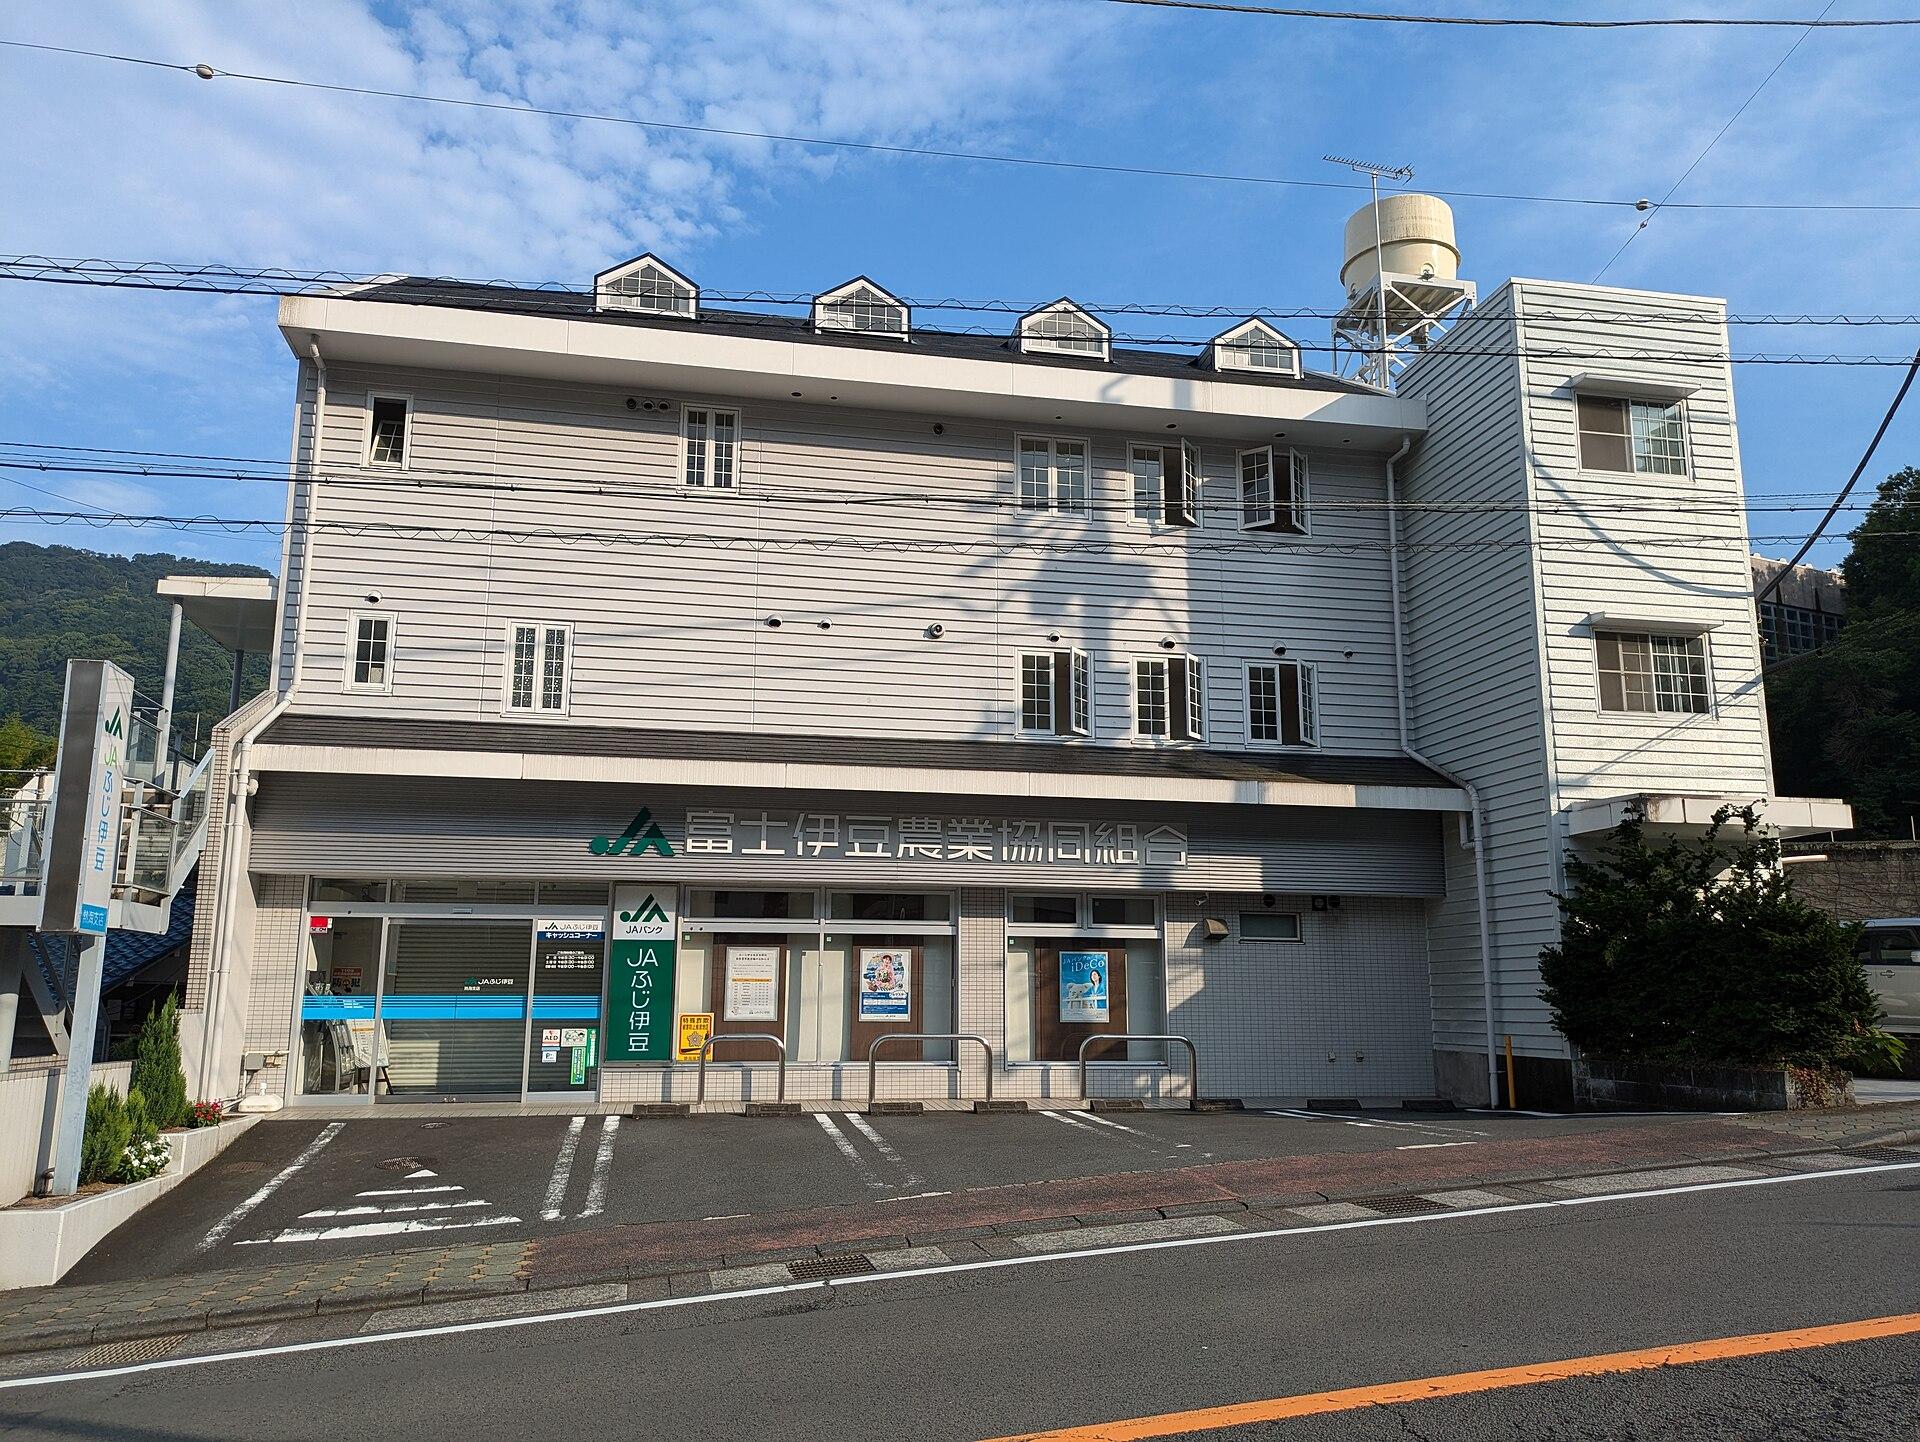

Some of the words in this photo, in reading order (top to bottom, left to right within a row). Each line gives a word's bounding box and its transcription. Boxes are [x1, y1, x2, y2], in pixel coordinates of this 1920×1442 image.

[685, 810, 1189, 867] 富士伊豆農業協同組合
[560, 923, 598, 931] JAふじ伊豆
[625, 925, 663, 935] JAバンク
[1071, 958, 1105, 972] iDeCo
[627, 948, 659, 1052] JAふじ伊豆
